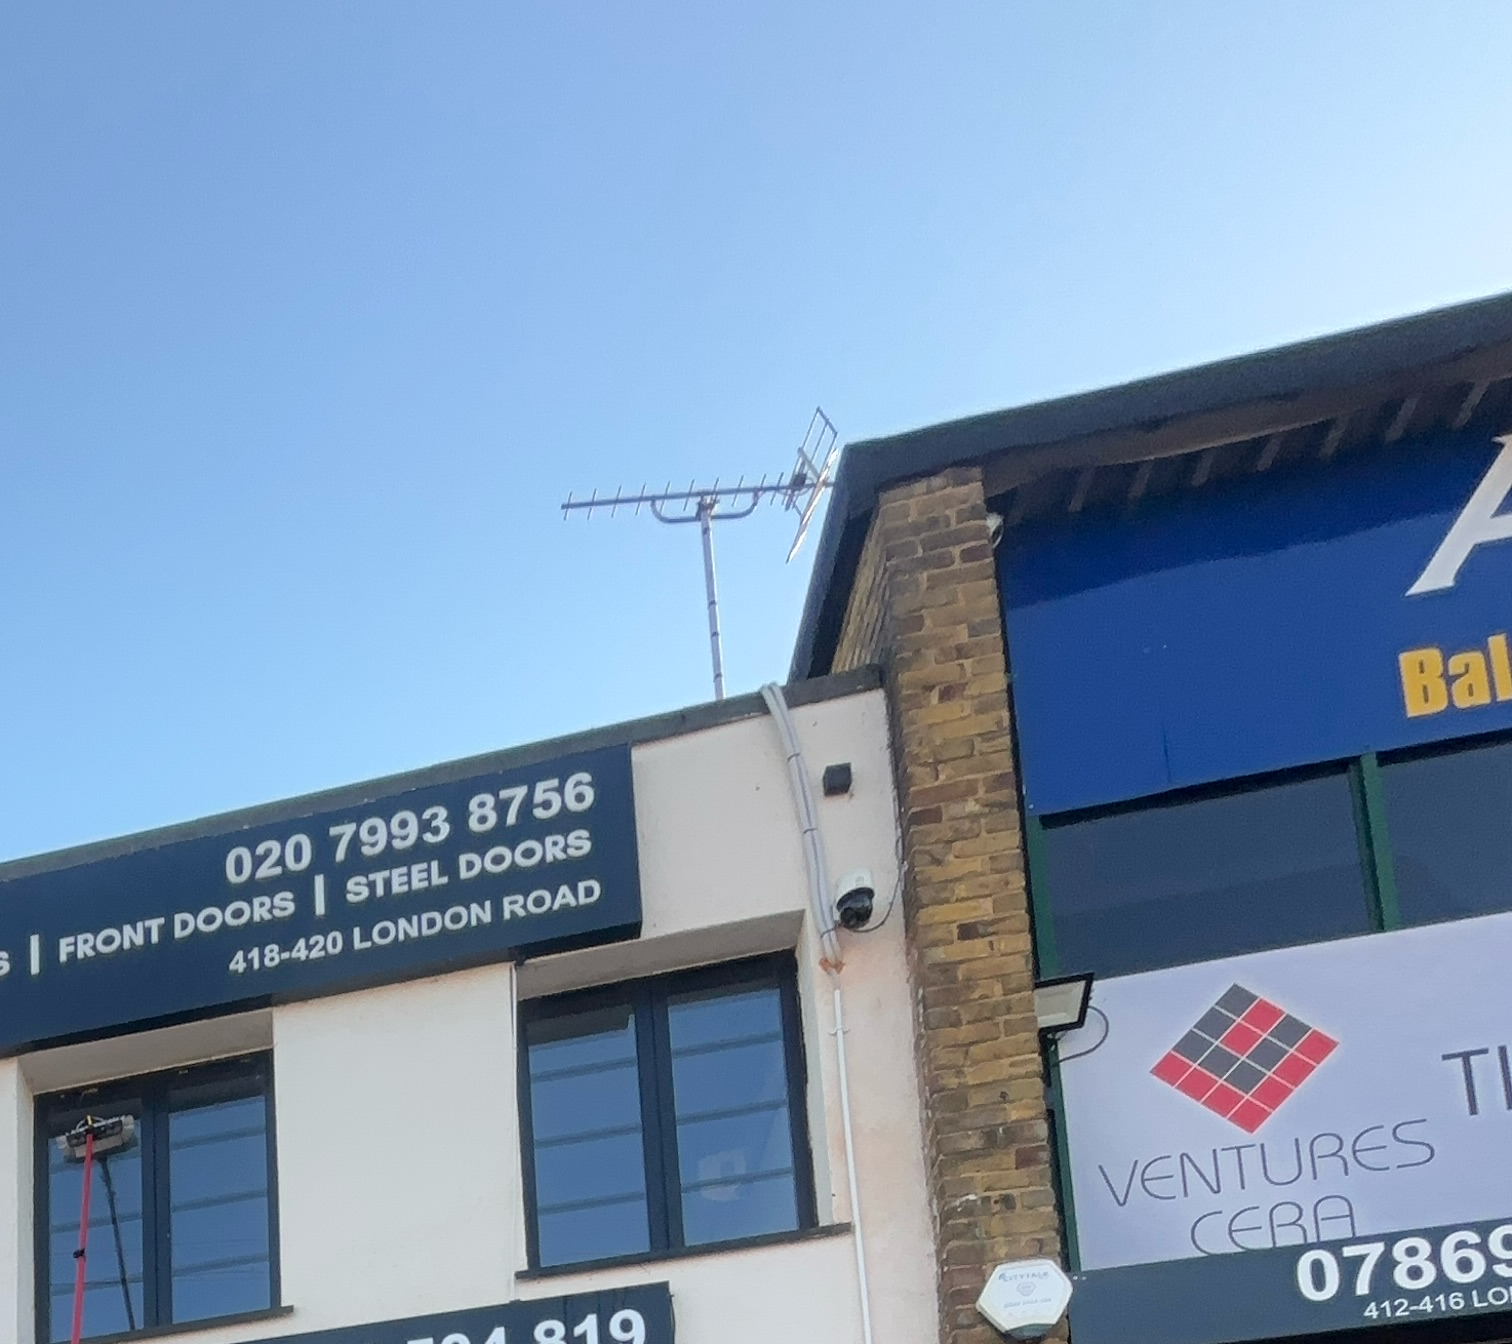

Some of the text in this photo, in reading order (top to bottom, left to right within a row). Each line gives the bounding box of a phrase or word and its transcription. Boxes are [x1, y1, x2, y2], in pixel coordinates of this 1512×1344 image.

[226, 773, 595, 884] 020 7993 8756
[346, 830, 592, 903] STEEL DOORS
[59, 892, 295, 963] FRONT DOORS
[229, 880, 601, 973] 418-420 LONDON ROAD
[1098, 1118, 1436, 1208] VENTURES
[1190, 1195, 1357, 1256] CERA
[1297, 1224, 1512, 1302] 07869
[1363, 1285, 1512, 1319] 412-416 LO
